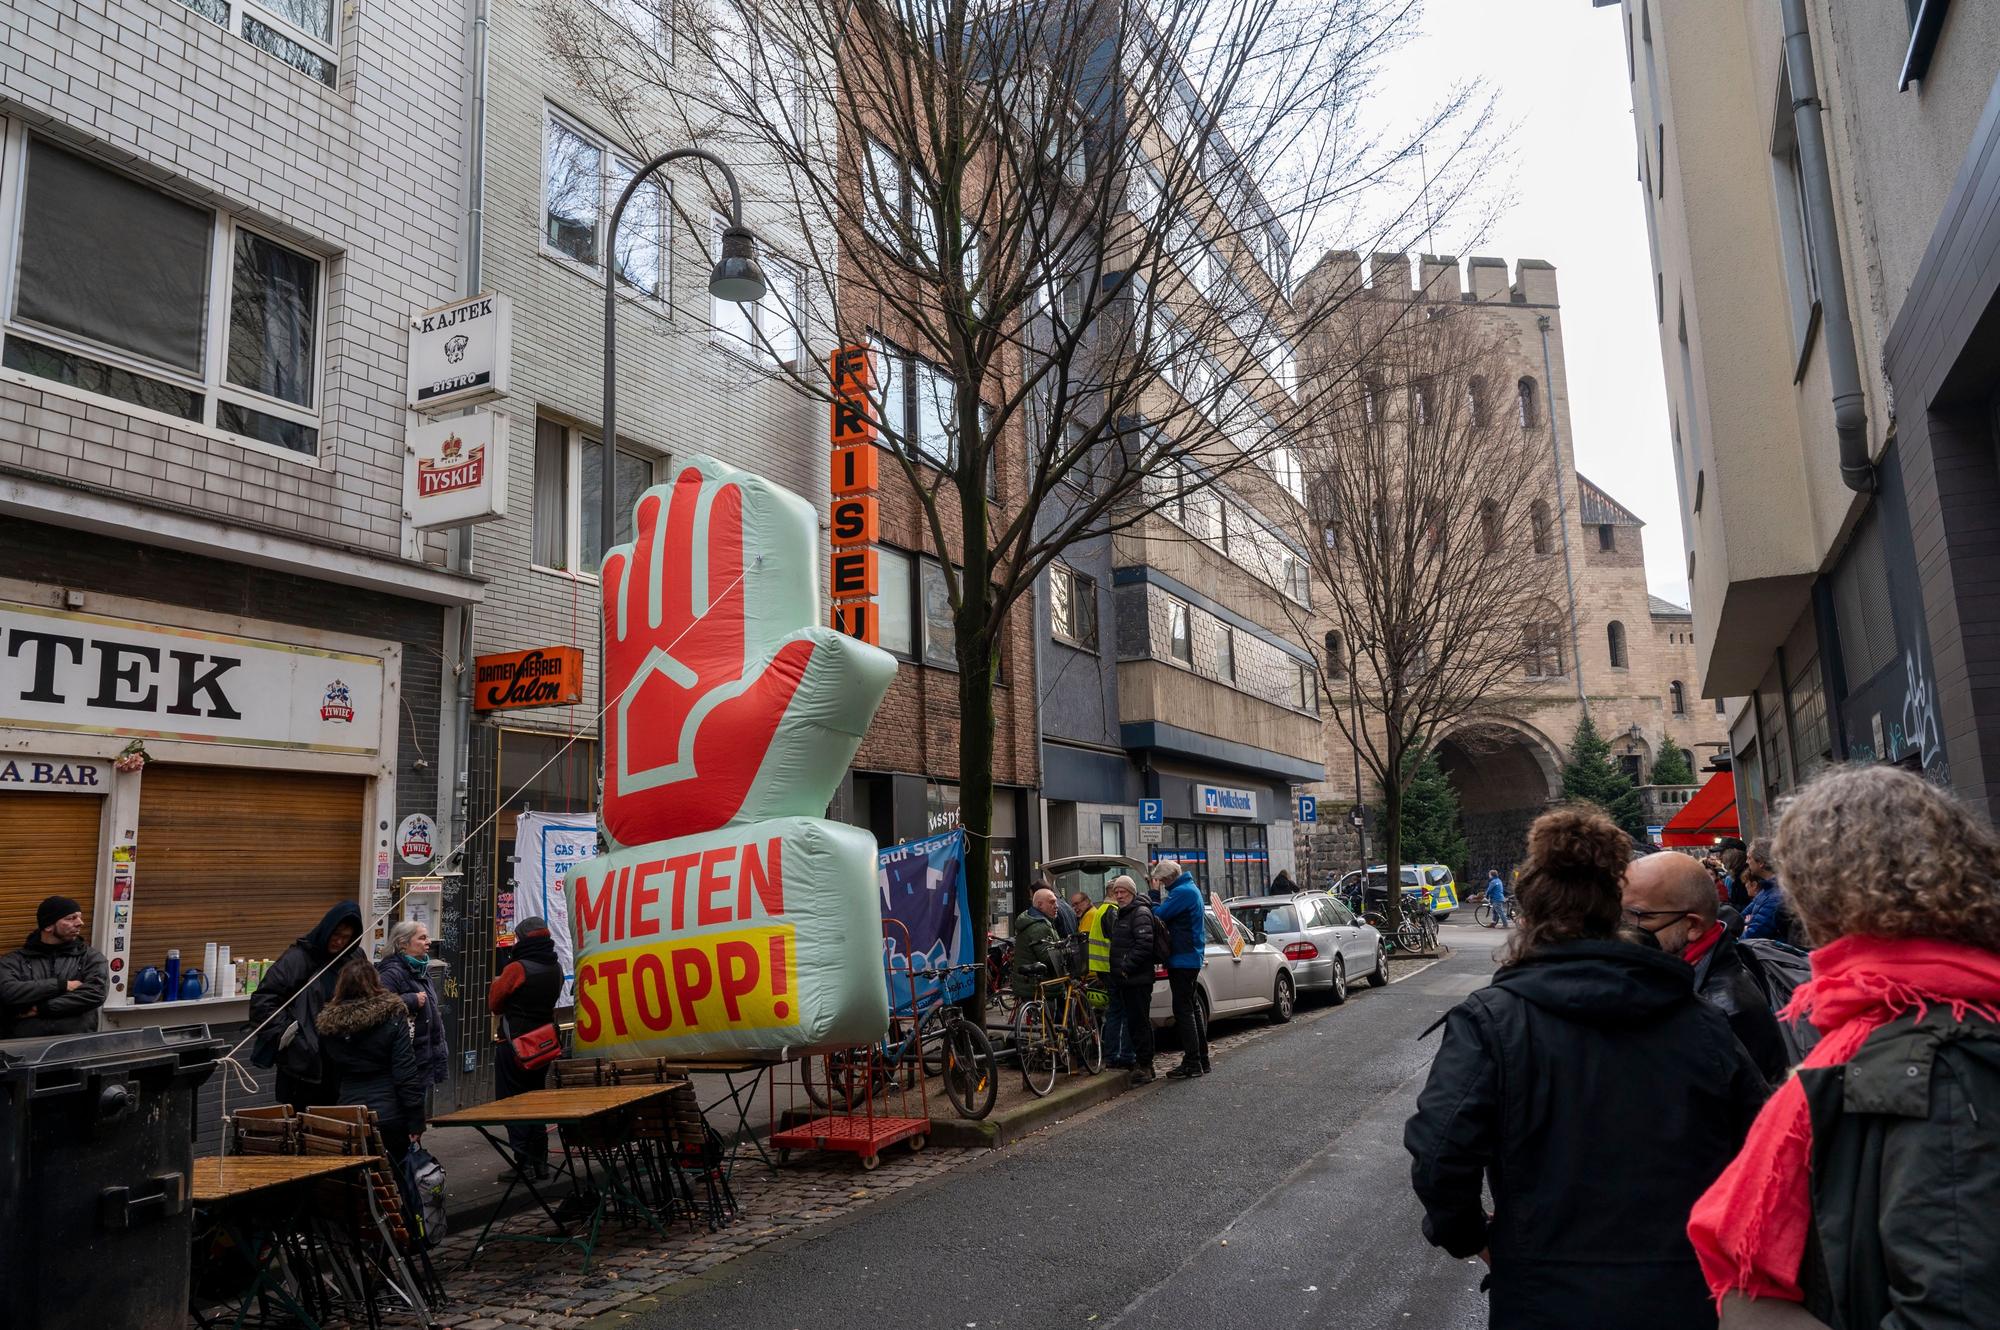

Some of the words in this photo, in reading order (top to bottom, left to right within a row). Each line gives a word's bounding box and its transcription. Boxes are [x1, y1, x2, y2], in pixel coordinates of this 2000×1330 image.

[422, 299, 492, 334] KAJTEK
[433, 372, 476, 393] BISTRO
[423, 463, 478, 492] TYSKIE
[0, 628, 242, 720] TEK
[480, 663, 517, 682] DAMEN
[488, 651, 561, 705] Salon
[30, 762, 99, 787] BAR
[1145, 802, 1157, 821] P
[1217, 790, 1251, 810] Volksbank
[554, 845, 574, 856] GAS
[879, 847, 908, 866] auf
[575, 837, 784, 949] MIETEN
[577, 935, 789, 1043] STOPP!
